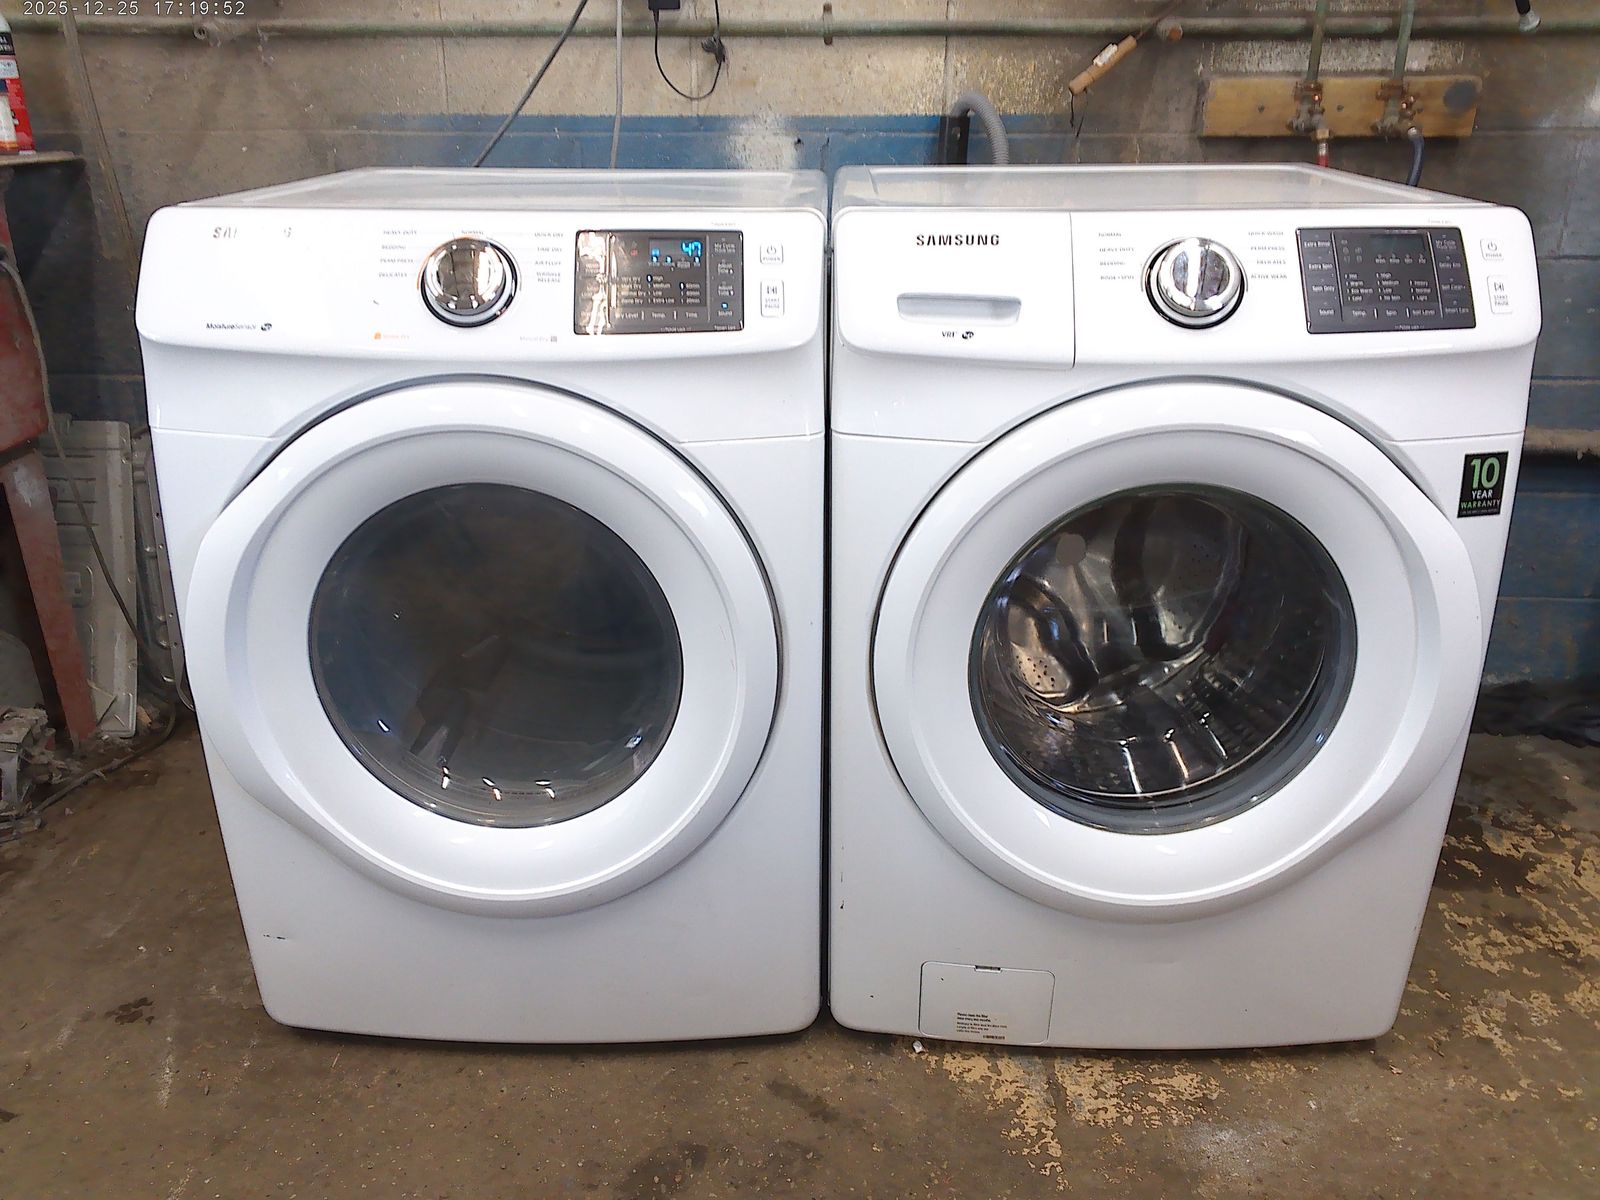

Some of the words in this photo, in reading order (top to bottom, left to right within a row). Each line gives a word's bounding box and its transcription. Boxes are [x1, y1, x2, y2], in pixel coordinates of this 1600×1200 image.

[916, 234, 1000, 246] SAMSUNG
[682, 242, 702, 257] 47
[1470, 457, 1500, 489] 10
[1471, 489, 1494, 500] YEAR
[1460, 499, 1502, 509] WARRANTY
